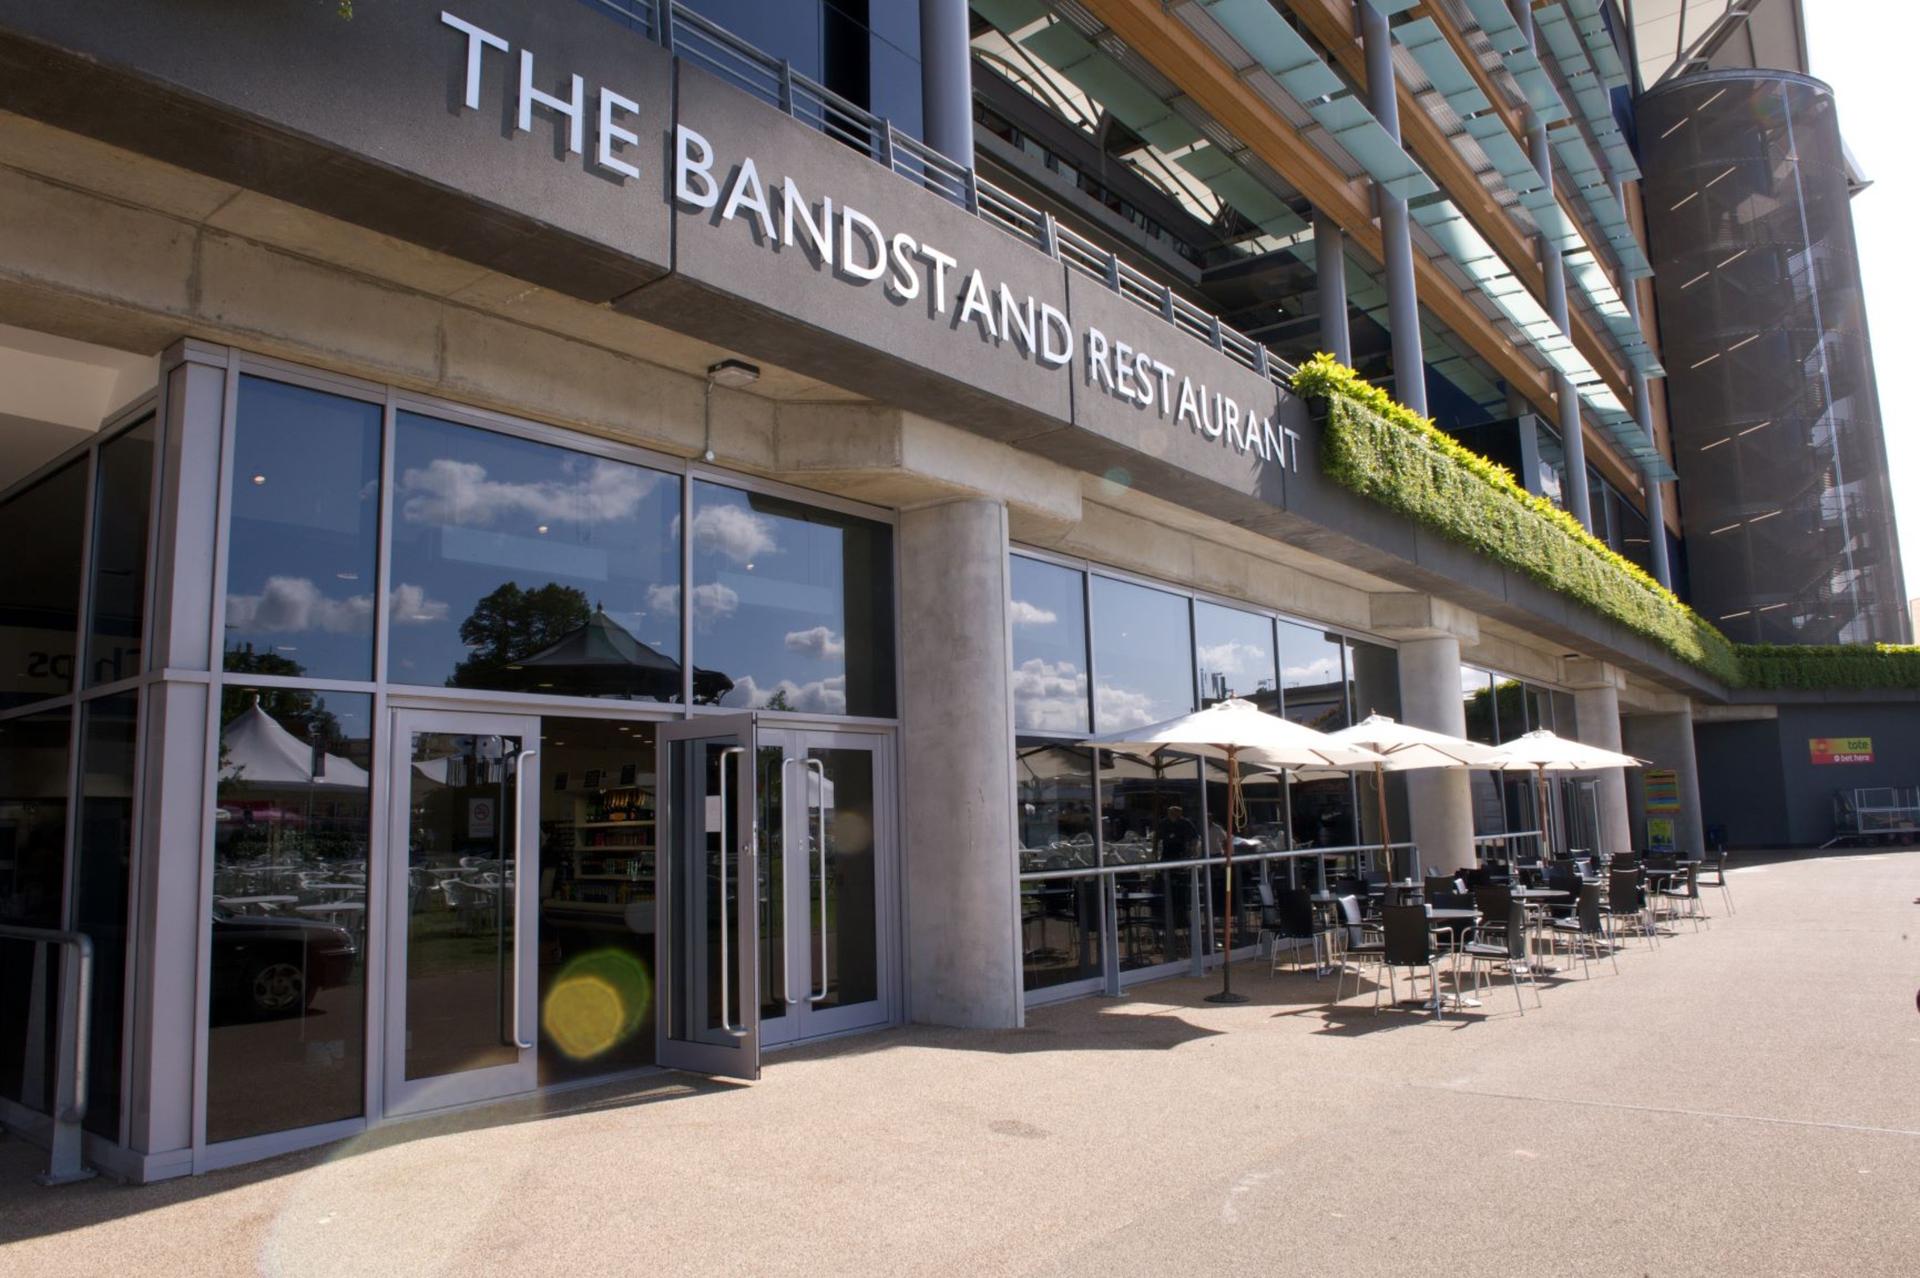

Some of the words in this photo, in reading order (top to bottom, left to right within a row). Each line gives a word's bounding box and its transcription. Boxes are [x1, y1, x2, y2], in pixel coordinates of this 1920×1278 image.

[441, 11, 640, 180] THE
[676, 124, 1074, 366] BANDSTAND
[1089, 327, 1301, 473] RESTAURANT
[1847, 741, 1870, 750] tote
[1841, 754, 1854, 762] bet
[1854, 754, 1870, 762] here
